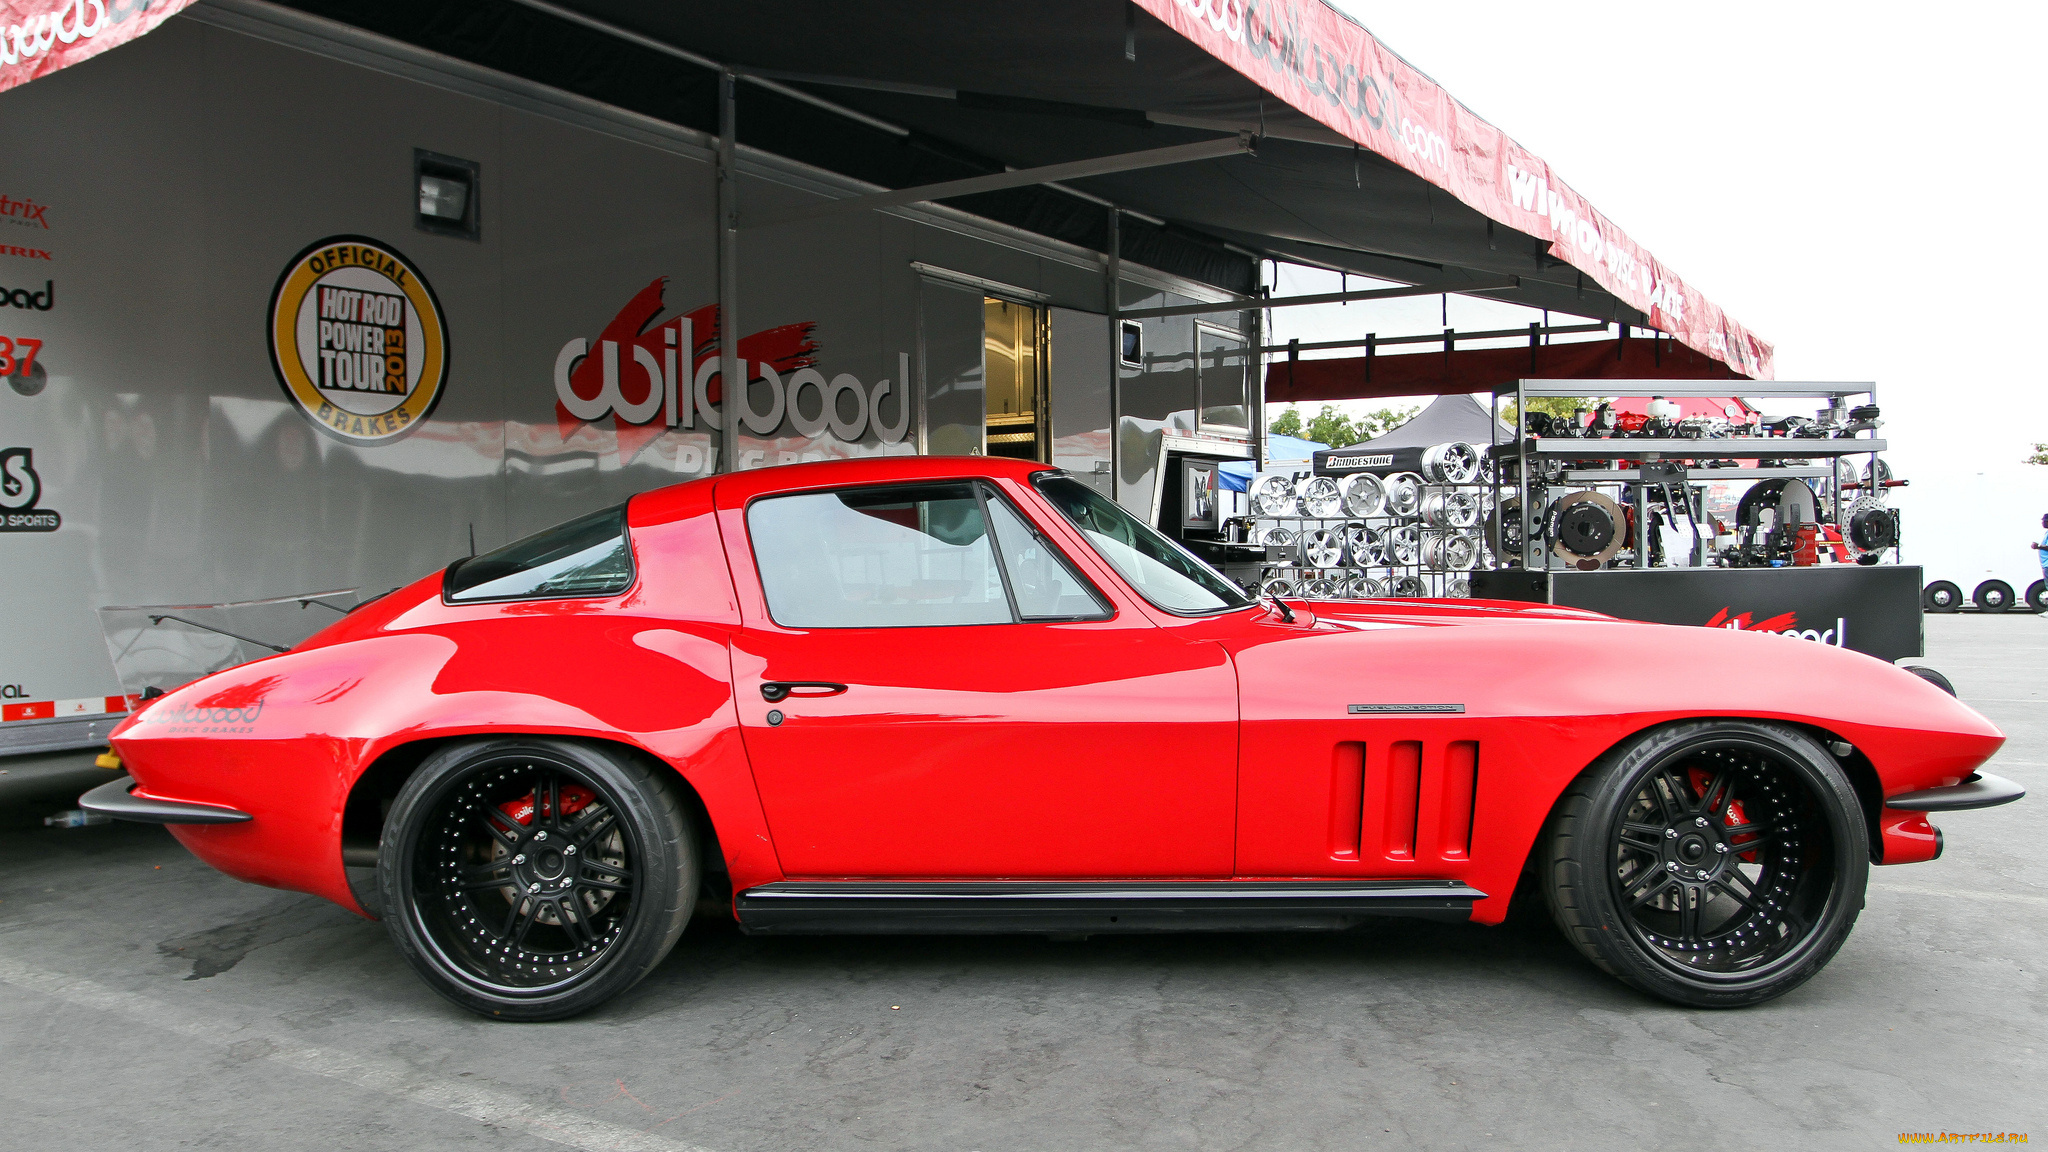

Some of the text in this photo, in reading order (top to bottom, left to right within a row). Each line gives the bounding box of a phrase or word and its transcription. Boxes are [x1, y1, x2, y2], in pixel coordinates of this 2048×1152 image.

[308, 246, 406, 286] OFFICIAL
[322, 287, 401, 327] HOT ROD
[320, 320, 385, 354] POWER
[320, 350, 386, 392] TOUR
[384, 328, 404, 393] 2013
[554, 316, 910, 446] wilwood
[316, 401, 411, 435] BRAKES
[1326, 455, 1392, 468] BRIDGESTONE
[8, 514, 57, 527] SPORTS
